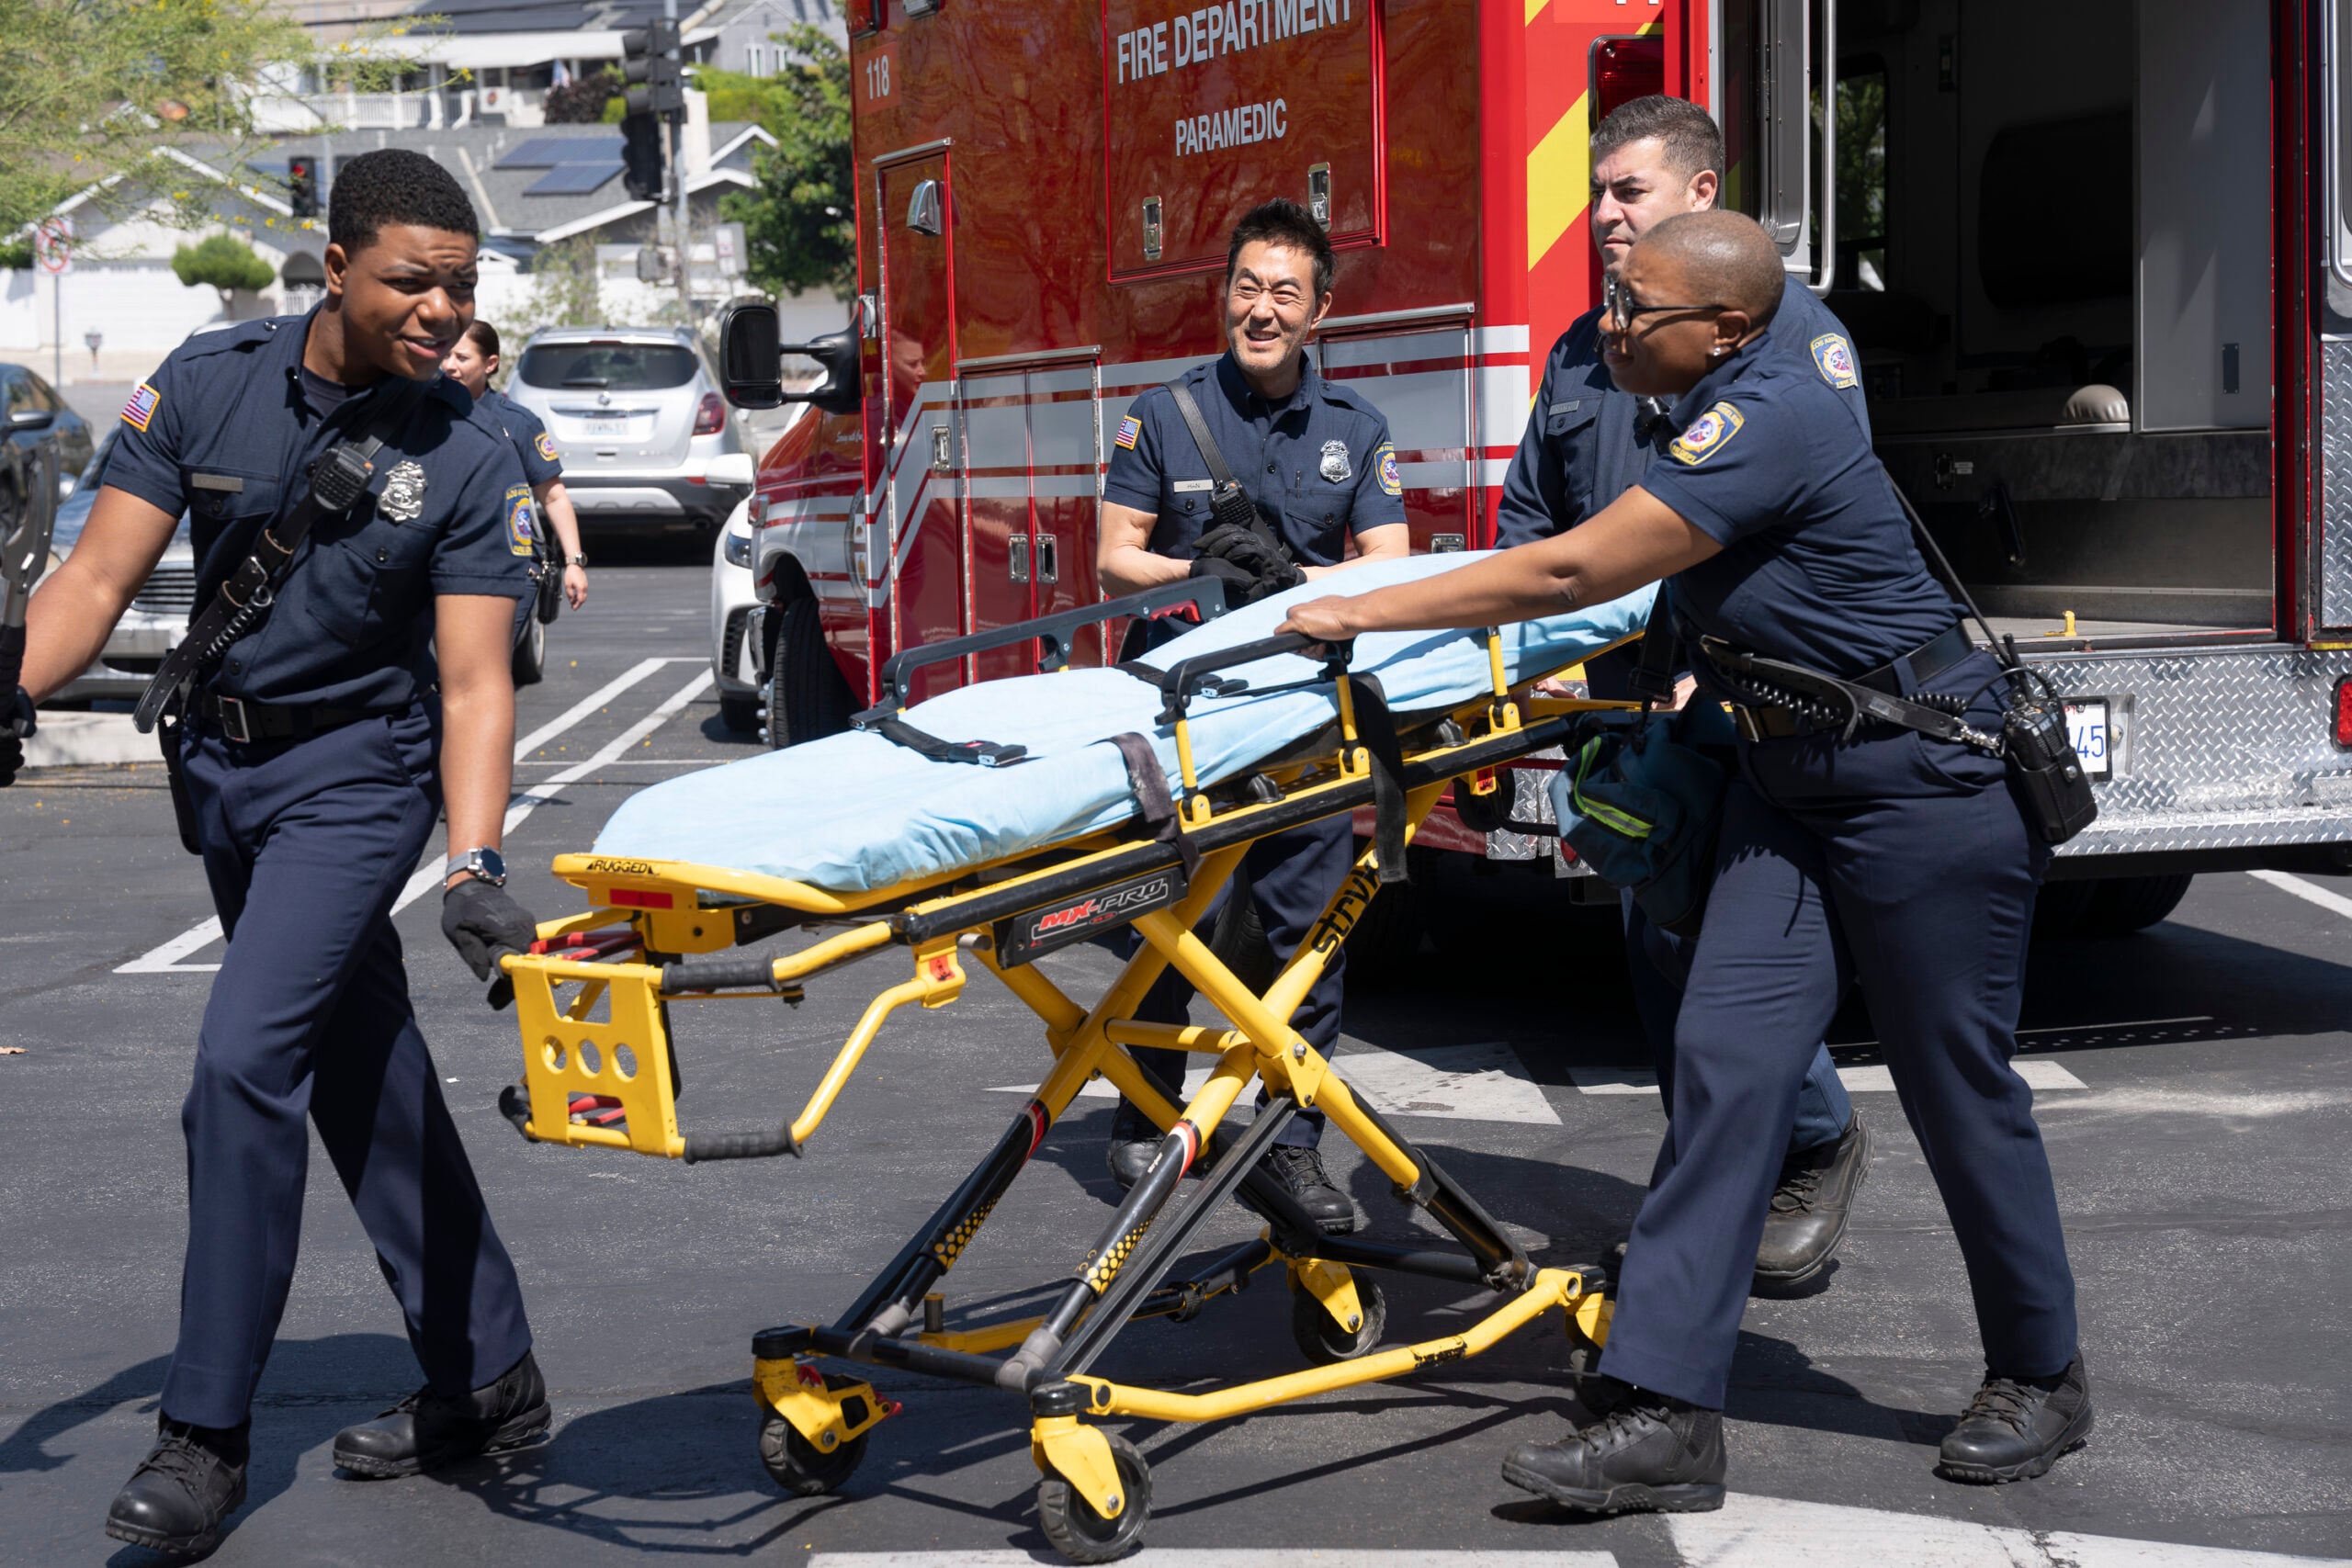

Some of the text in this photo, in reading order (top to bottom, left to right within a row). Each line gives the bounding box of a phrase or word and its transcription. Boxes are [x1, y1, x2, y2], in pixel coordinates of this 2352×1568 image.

[866, 54, 889, 100] 118
[1117, 21, 1168, 85] FIRE
[1175, 98, 1286, 157] PARAMEDIC
[594, 860, 648, 874] RUGGED
[1038, 878, 1165, 931] MX-PRO
